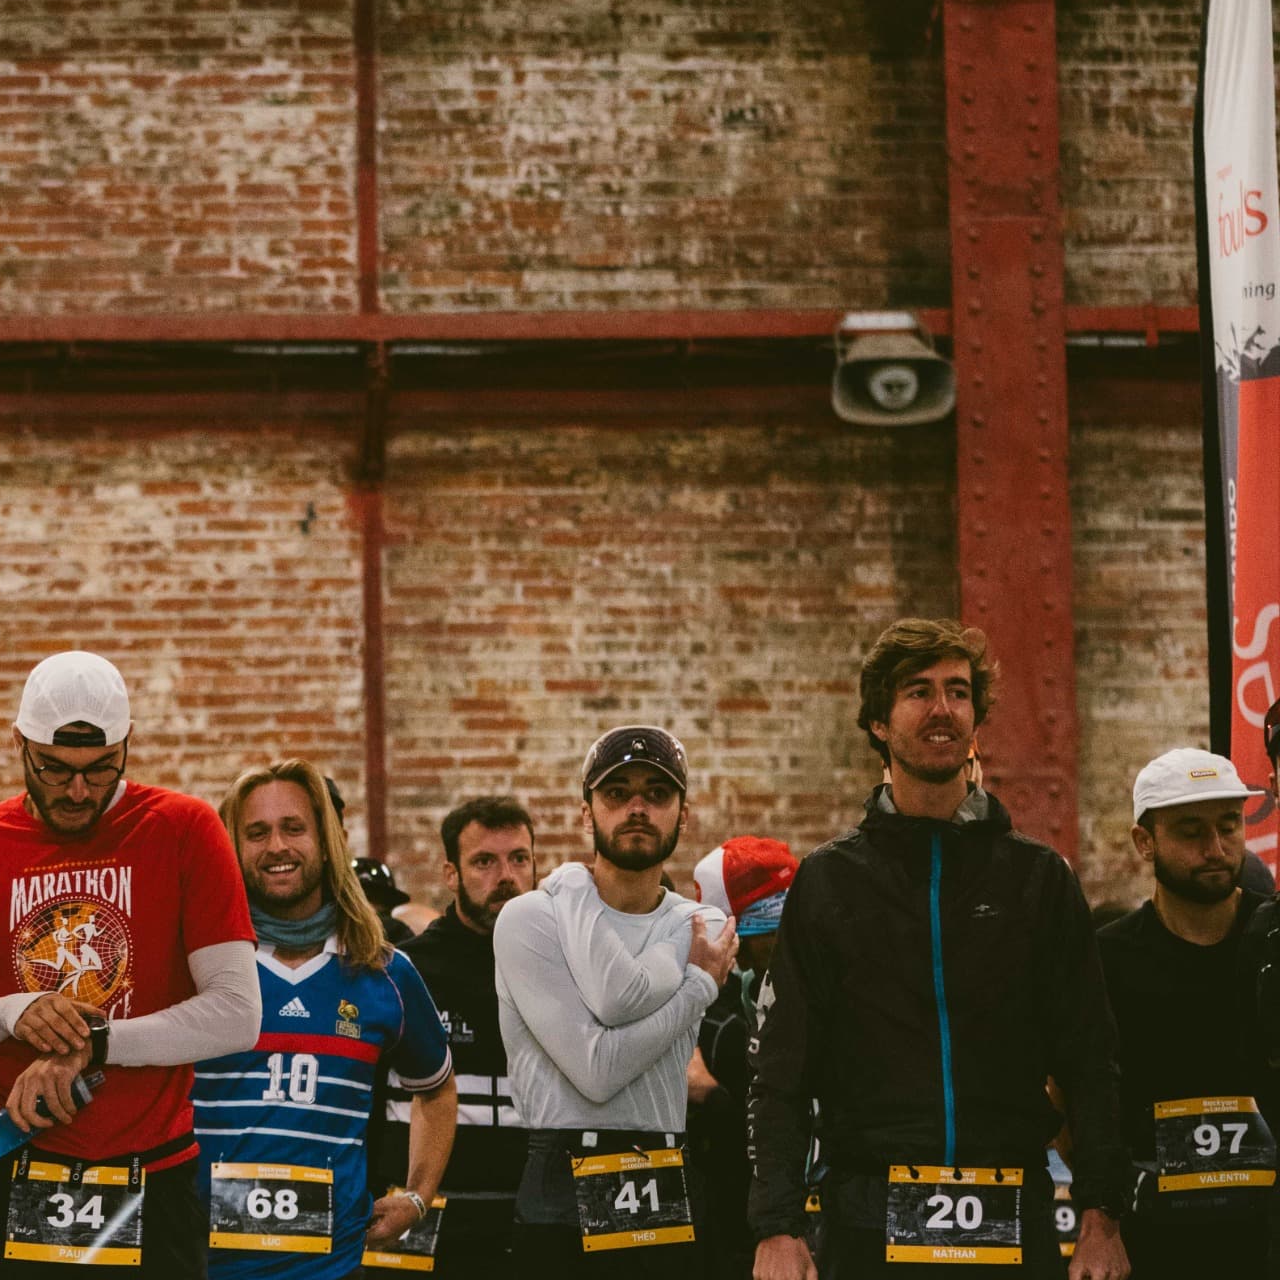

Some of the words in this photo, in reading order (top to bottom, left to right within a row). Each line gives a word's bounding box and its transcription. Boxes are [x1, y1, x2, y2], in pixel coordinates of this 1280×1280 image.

[9, 865, 132, 933] MARATHON
[279, 1009, 310, 1019] adidas
[262, 1052, 319, 1105] 10
[1193, 1122, 1249, 1157] 97
[1200, 1173, 1250, 1184] VALENTIN
[46, 1193, 105, 1230] 34
[247, 1187, 299, 1221] 68
[614, 1179, 660, 1214] 41
[926, 1194, 984, 1230] 20
[932, 1248, 977, 1259] NATHAN
